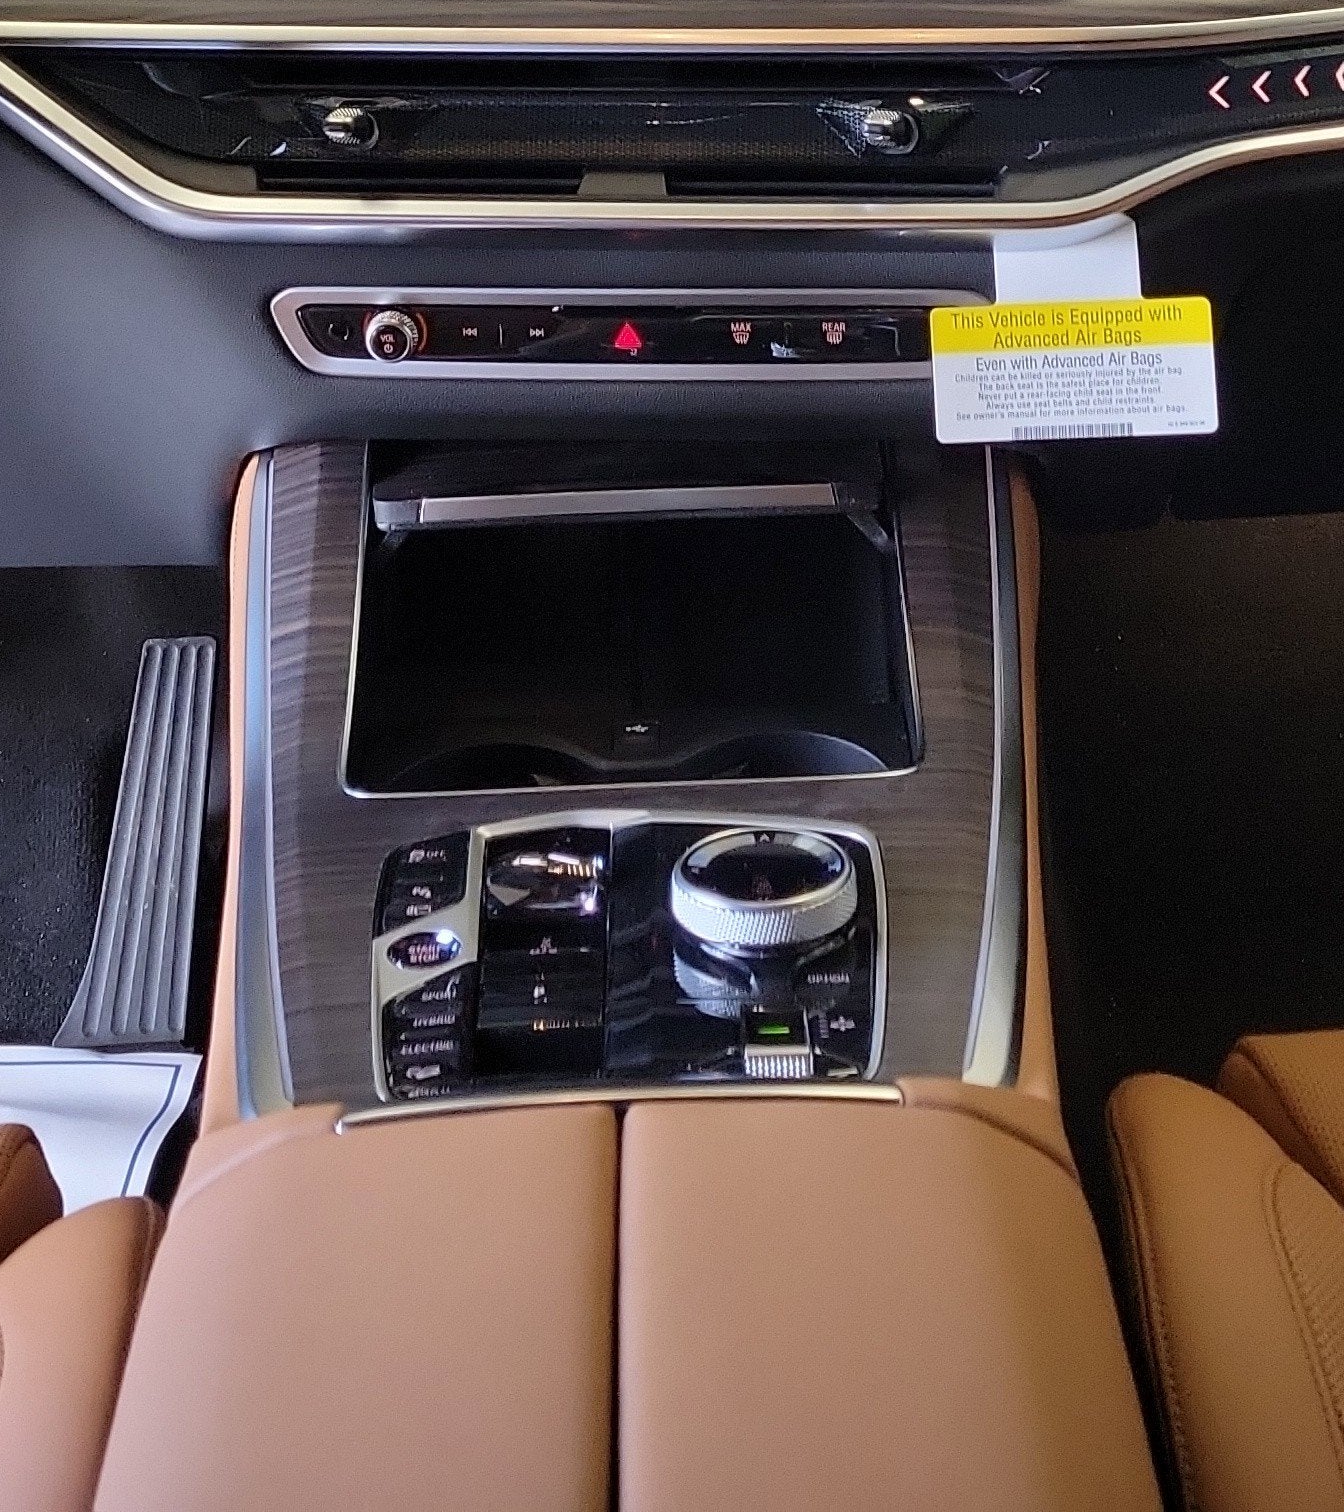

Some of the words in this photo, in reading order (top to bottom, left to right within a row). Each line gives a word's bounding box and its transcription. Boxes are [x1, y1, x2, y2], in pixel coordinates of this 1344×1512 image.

[951, 312, 984, 330] This
[989, 309, 1046, 328] Vehicle
[1051, 309, 1064, 326] is
[1070, 305, 1143, 327] Equipped
[1149, 304, 1182, 323] with
[730, 321, 752, 333] MAX
[821, 321, 847, 333] REAR
[379, 333, 396, 343] VOL
[993, 330, 1069, 349] Advanced
[1076, 329, 1096, 346] Air
[1104, 328, 1142, 347] Bags
[976, 357, 1006, 373] Even
[1010, 355, 1038, 371] with
[1042, 352, 1104, 370] Advanced
[1108, 351, 1127, 366] Air
[1131, 350, 1163, 368] Bags
[955, 373, 989, 383] Children
[991, 374, 1005, 382] can
[1008, 372, 1018, 381] be
[1020, 371, 1042, 380] killed
[1126, 367, 1135, 378] by
[1138, 366, 1151, 376] the
[1154, 366, 1164, 375] air
[979, 382, 993, 392] The
[996, 381, 1014, 391] back
[1017, 380, 1034, 389] seat
[1046, 379, 1059, 389] the
[978, 392, 1001, 402] Never
[1004, 391, 1017, 402] put
[1126, 386, 1138, 395] the
[986, 400, 1014, 411] Always
